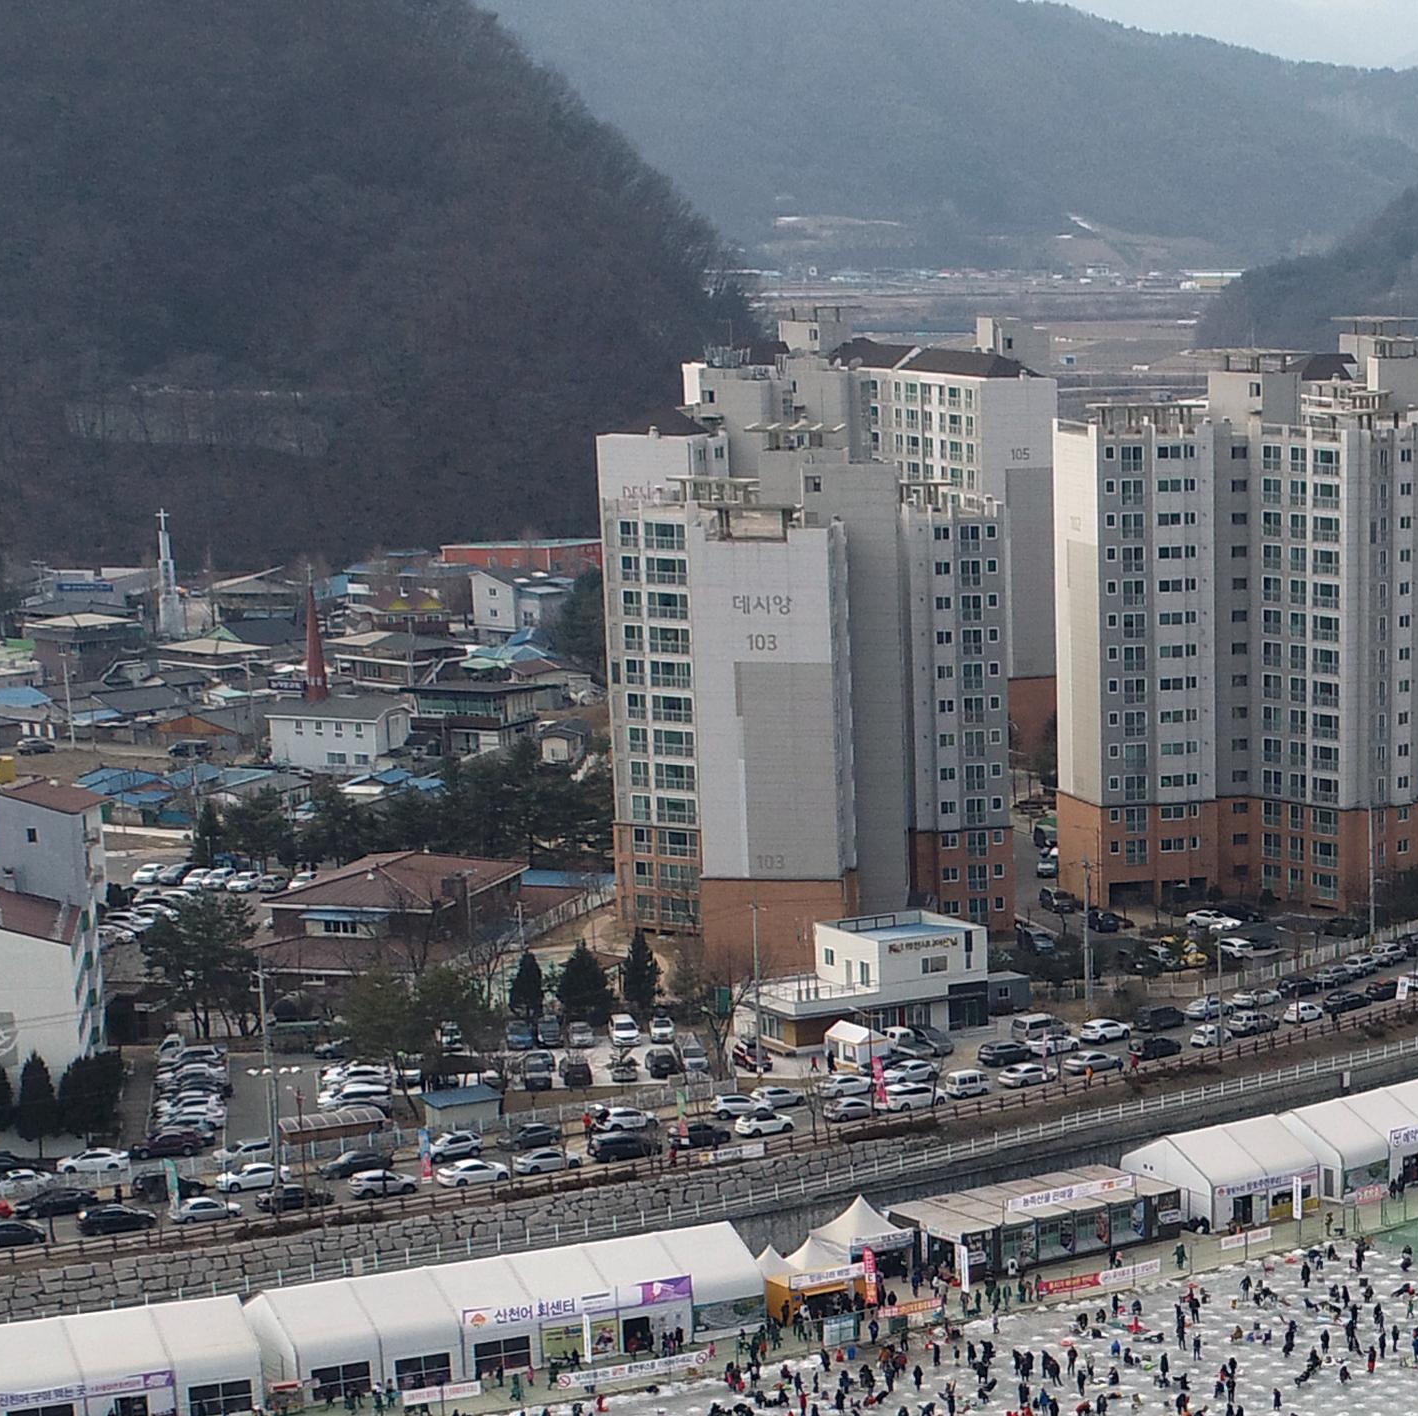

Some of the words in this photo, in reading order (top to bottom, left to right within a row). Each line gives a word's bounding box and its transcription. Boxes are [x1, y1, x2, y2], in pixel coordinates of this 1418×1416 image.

[1010, 447, 1030, 460] 105
[732, 595, 793, 615] 데시앙
[746, 633, 778, 651] 103
[756, 854, 785, 869] 103
[494, 1305, 532, 1324] 산천어
[537, 1298, 576, 1317] 회센터
